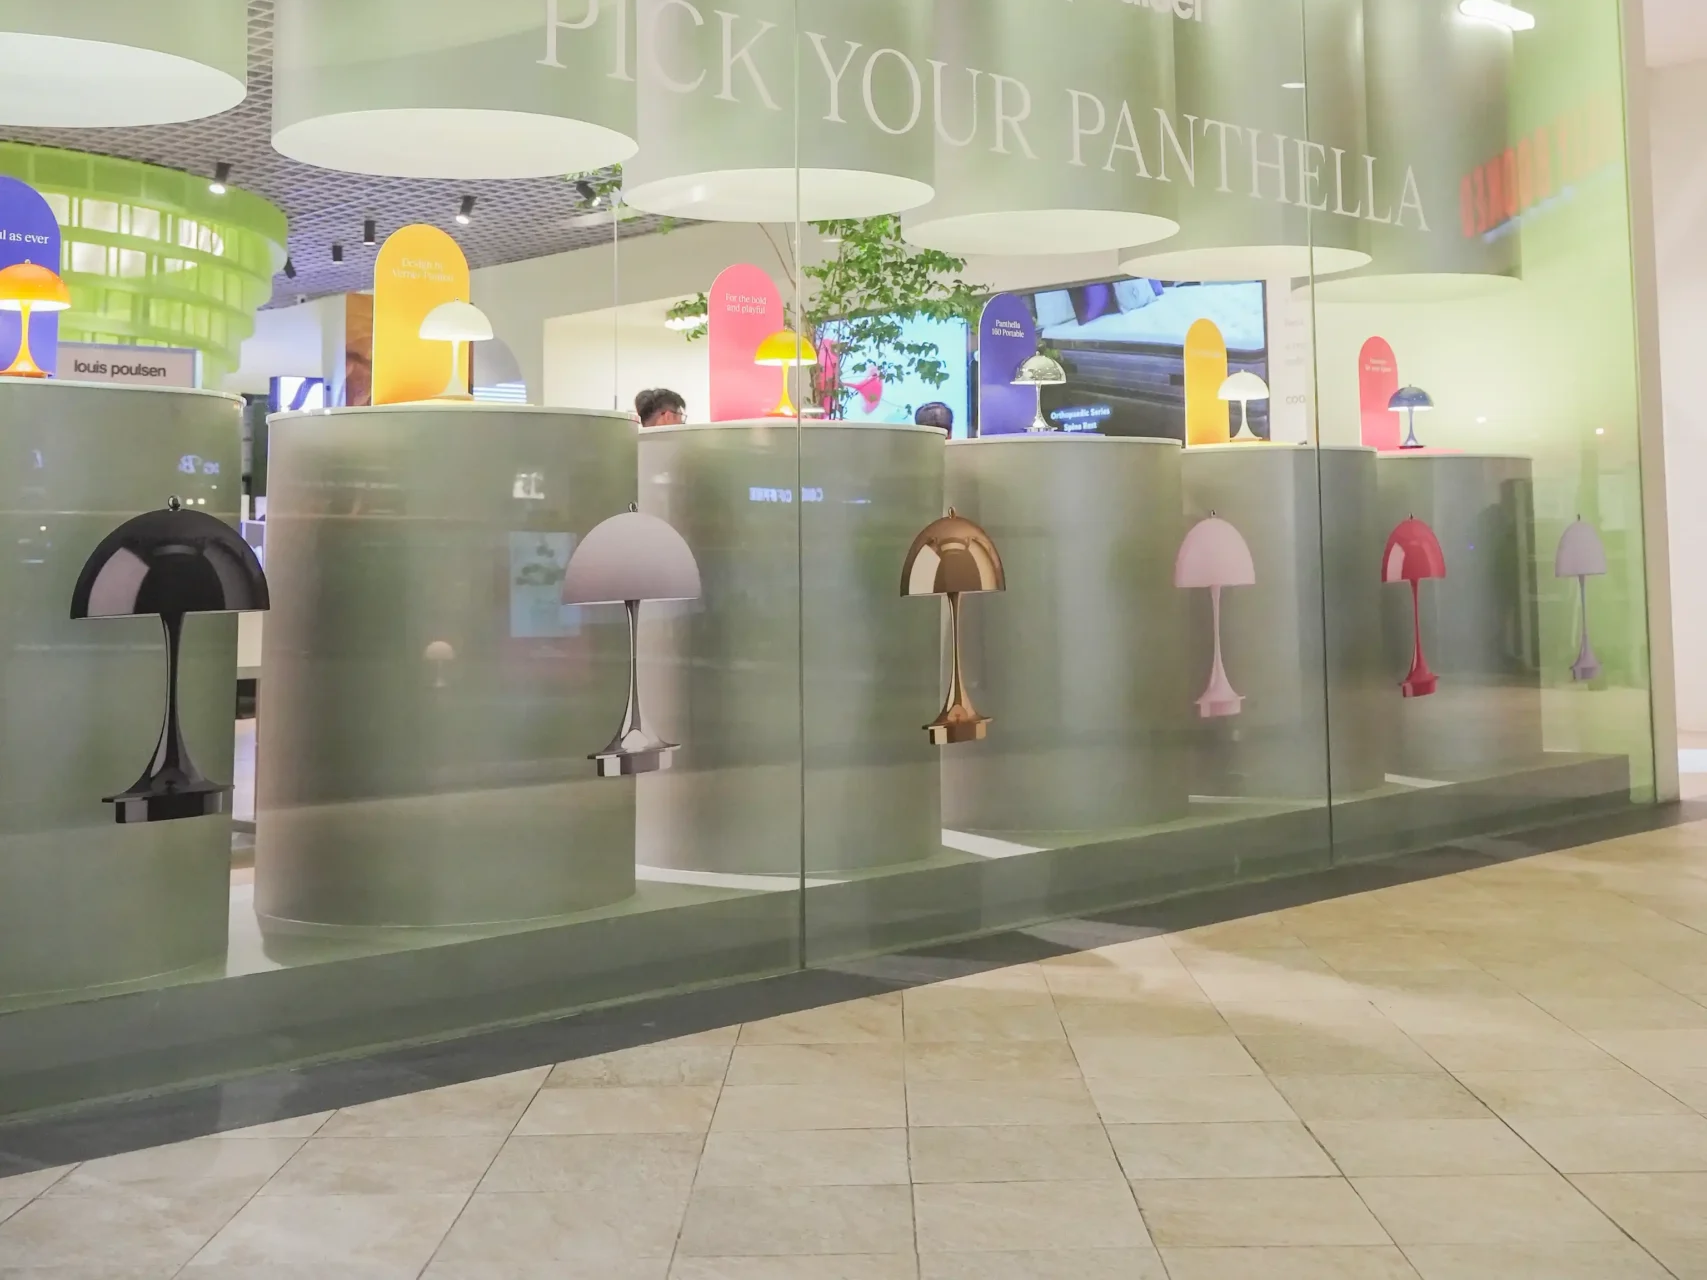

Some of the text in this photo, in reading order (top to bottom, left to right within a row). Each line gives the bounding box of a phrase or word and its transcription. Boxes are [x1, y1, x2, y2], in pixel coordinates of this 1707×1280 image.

[804, 31, 1040, 160] YOUR
[1065, 88, 1432, 233] PANTHELLA
[9, 232, 23, 242] as
[24, 233, 50, 245] ever
[725, 292, 767, 305] For the bold
[726, 303, 766, 315] and playful
[995, 319, 1021, 329] Panthella
[1002, 328, 1025, 339] Portable
[74, 359, 167, 378] louis poulsen
[1090, 407, 1111, 417] Series
